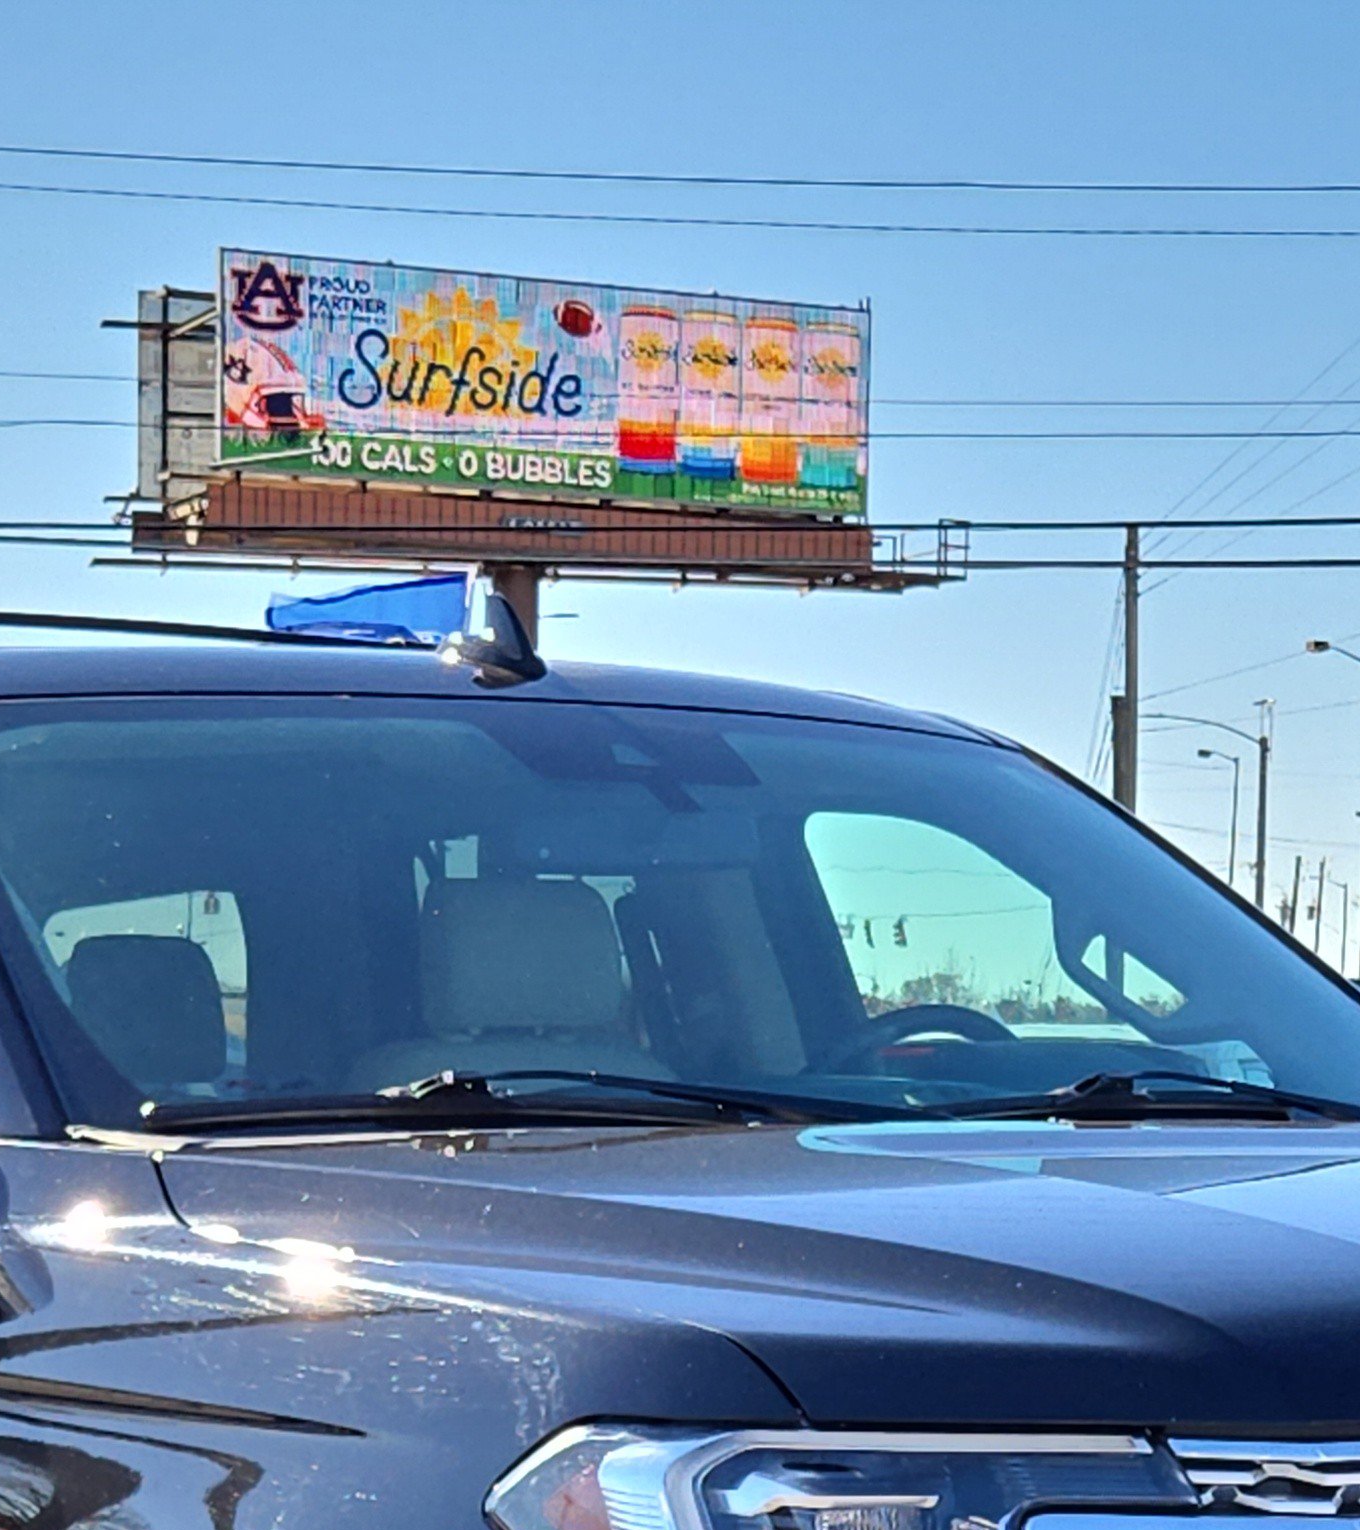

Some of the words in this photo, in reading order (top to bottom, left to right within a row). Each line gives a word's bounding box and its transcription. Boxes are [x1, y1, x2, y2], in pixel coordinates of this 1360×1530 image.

[308, 276, 371, 294] PROUD
[308, 294, 387, 315] PARTNER
[337, 328, 583, 417] Surfside
[360, 442, 437, 474] CALS
[486, 452, 613, 488] BUBBLES
